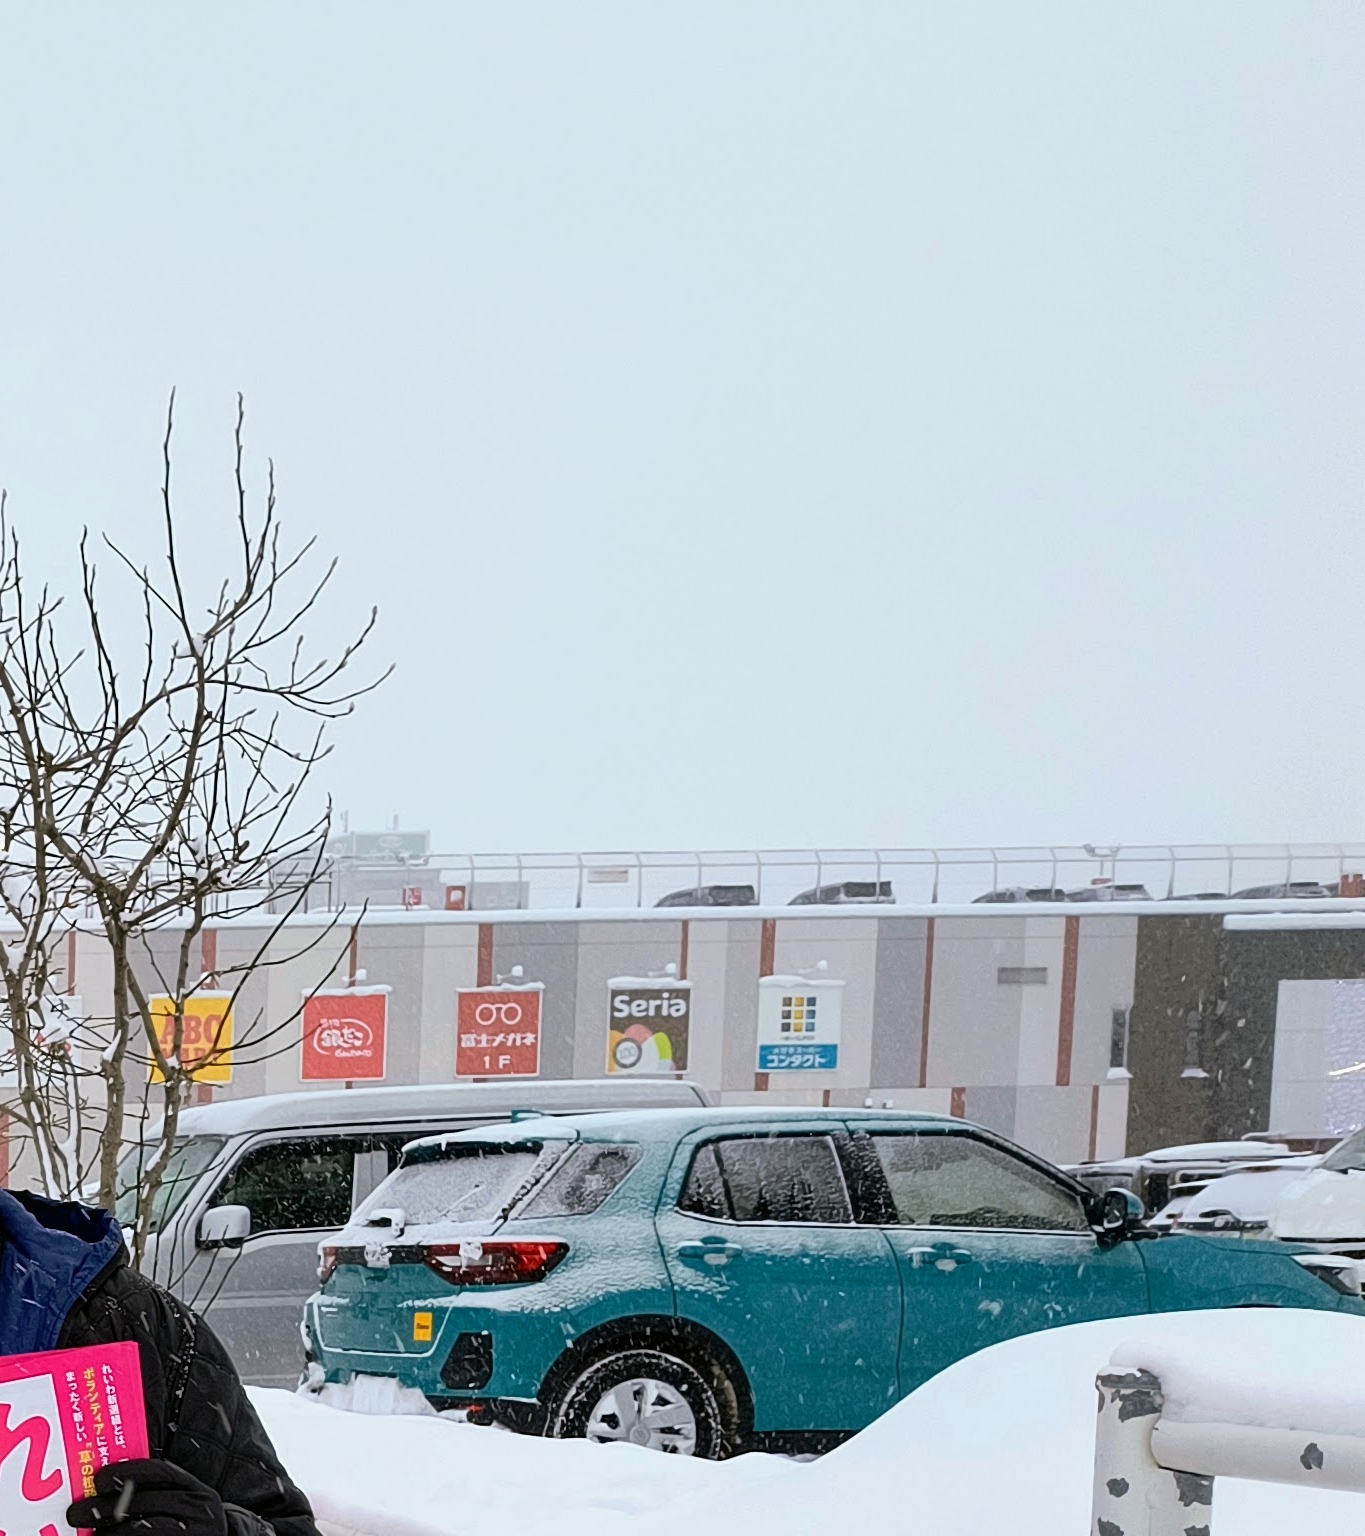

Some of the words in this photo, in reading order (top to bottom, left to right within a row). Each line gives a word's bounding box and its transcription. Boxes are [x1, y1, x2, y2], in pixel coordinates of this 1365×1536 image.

[613, 992, 686, 1018] Seria
[159, 1013, 222, 1045] ABC
[460, 1032, 537, 1048] 富士メガネ
[766, 1054, 827, 1068] コンタクト
